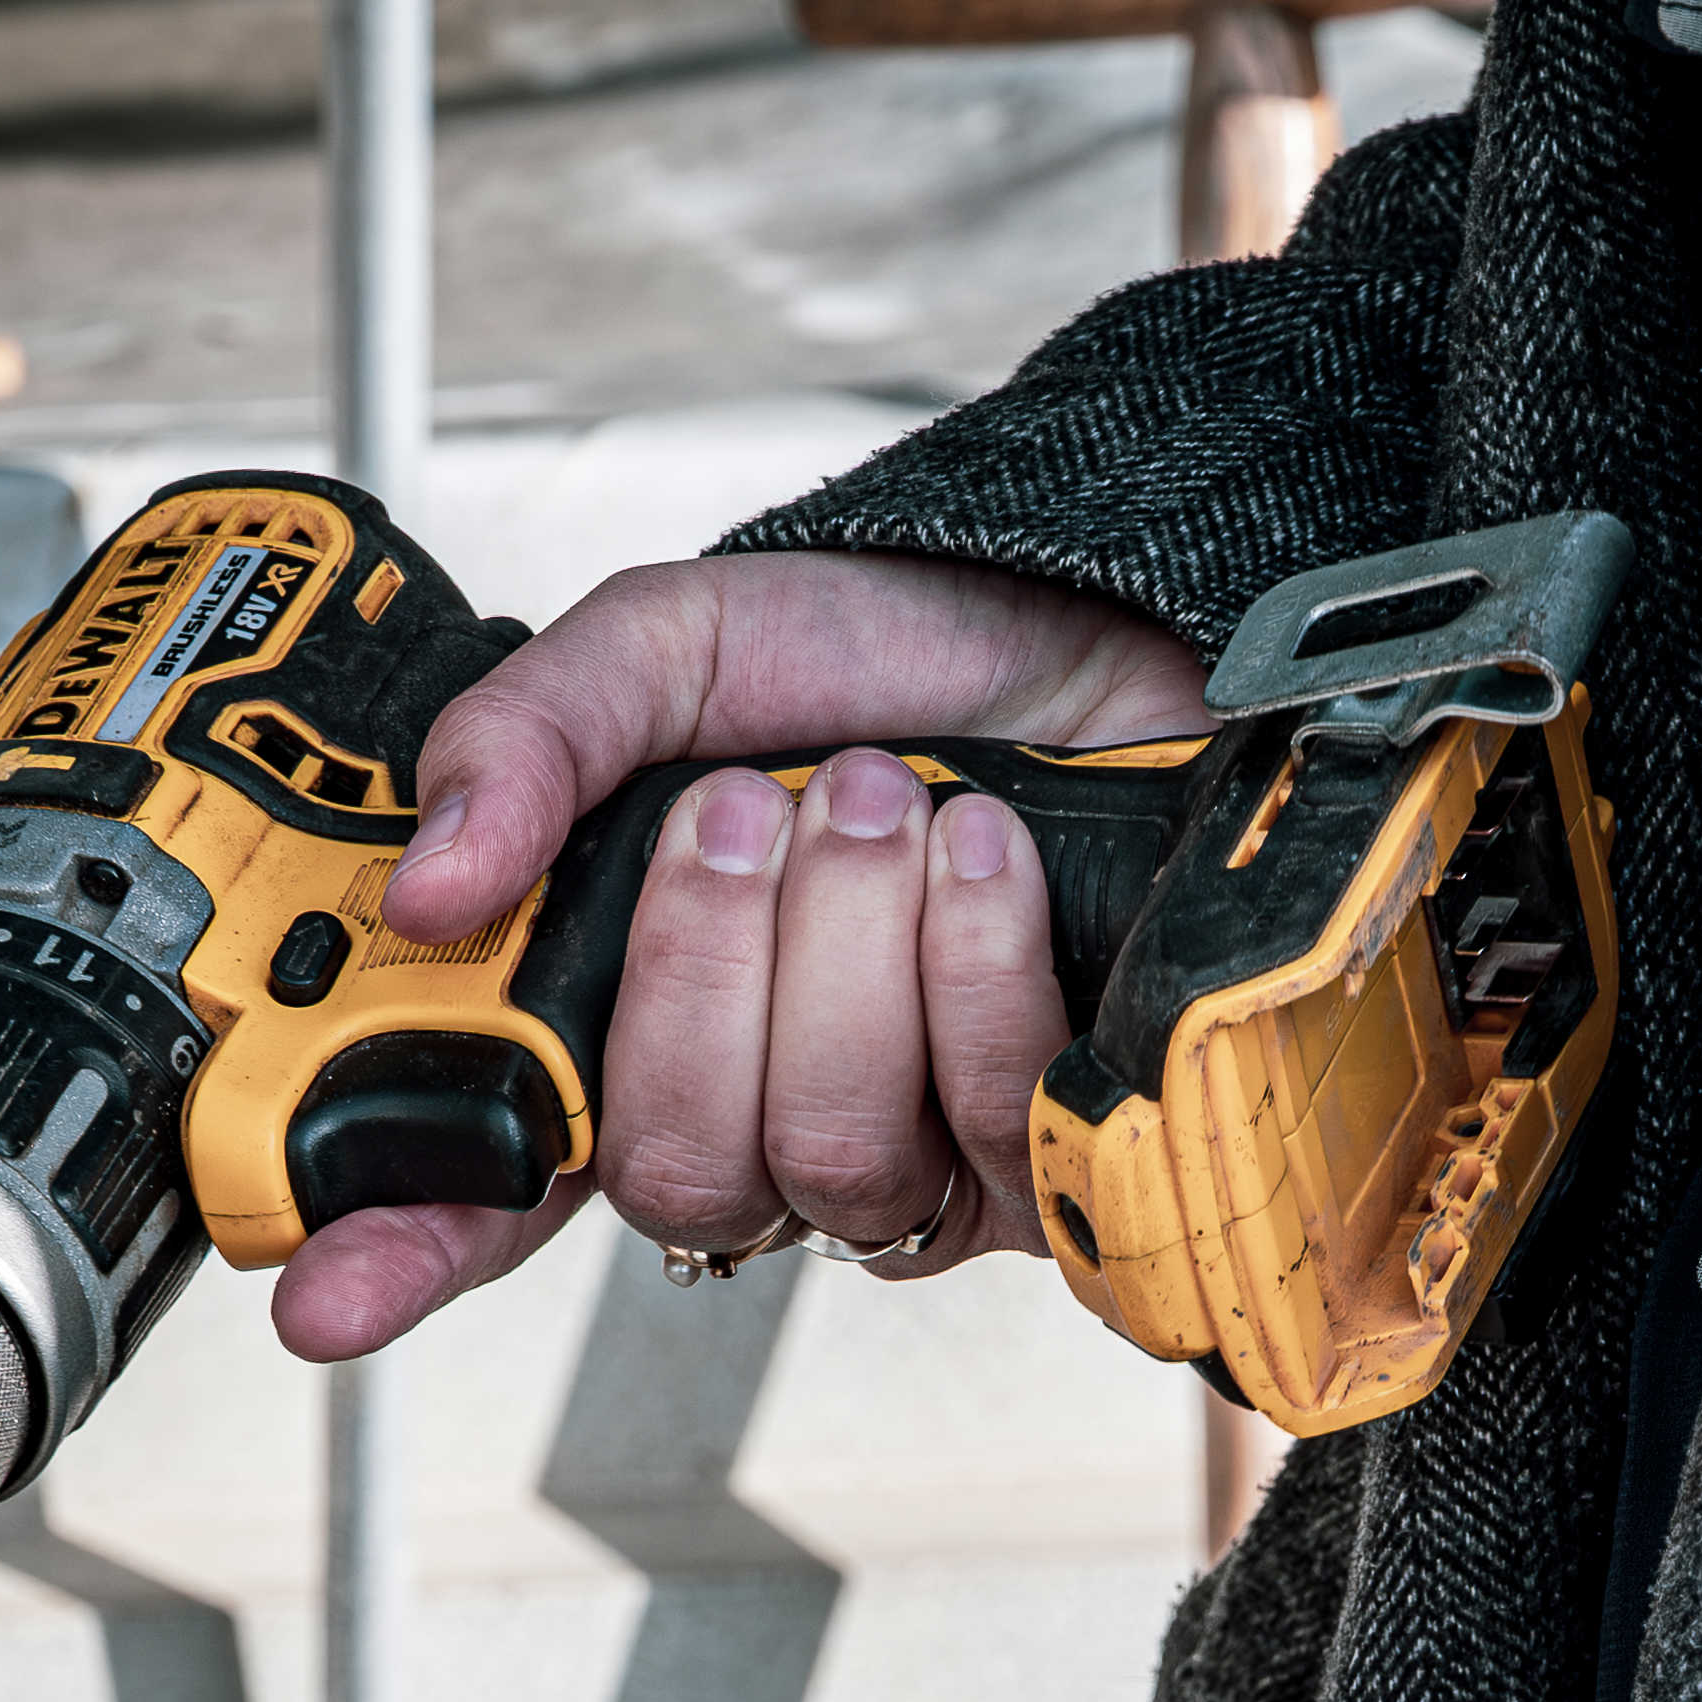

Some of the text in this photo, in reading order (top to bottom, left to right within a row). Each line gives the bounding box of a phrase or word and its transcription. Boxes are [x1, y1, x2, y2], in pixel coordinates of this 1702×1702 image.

[11, 540, 195, 738] DEWALT
[150, 553, 252, 679] BRUSHLESS
[225, 562, 304, 643] 18V XR
[33, 934, 96, 983] 11
